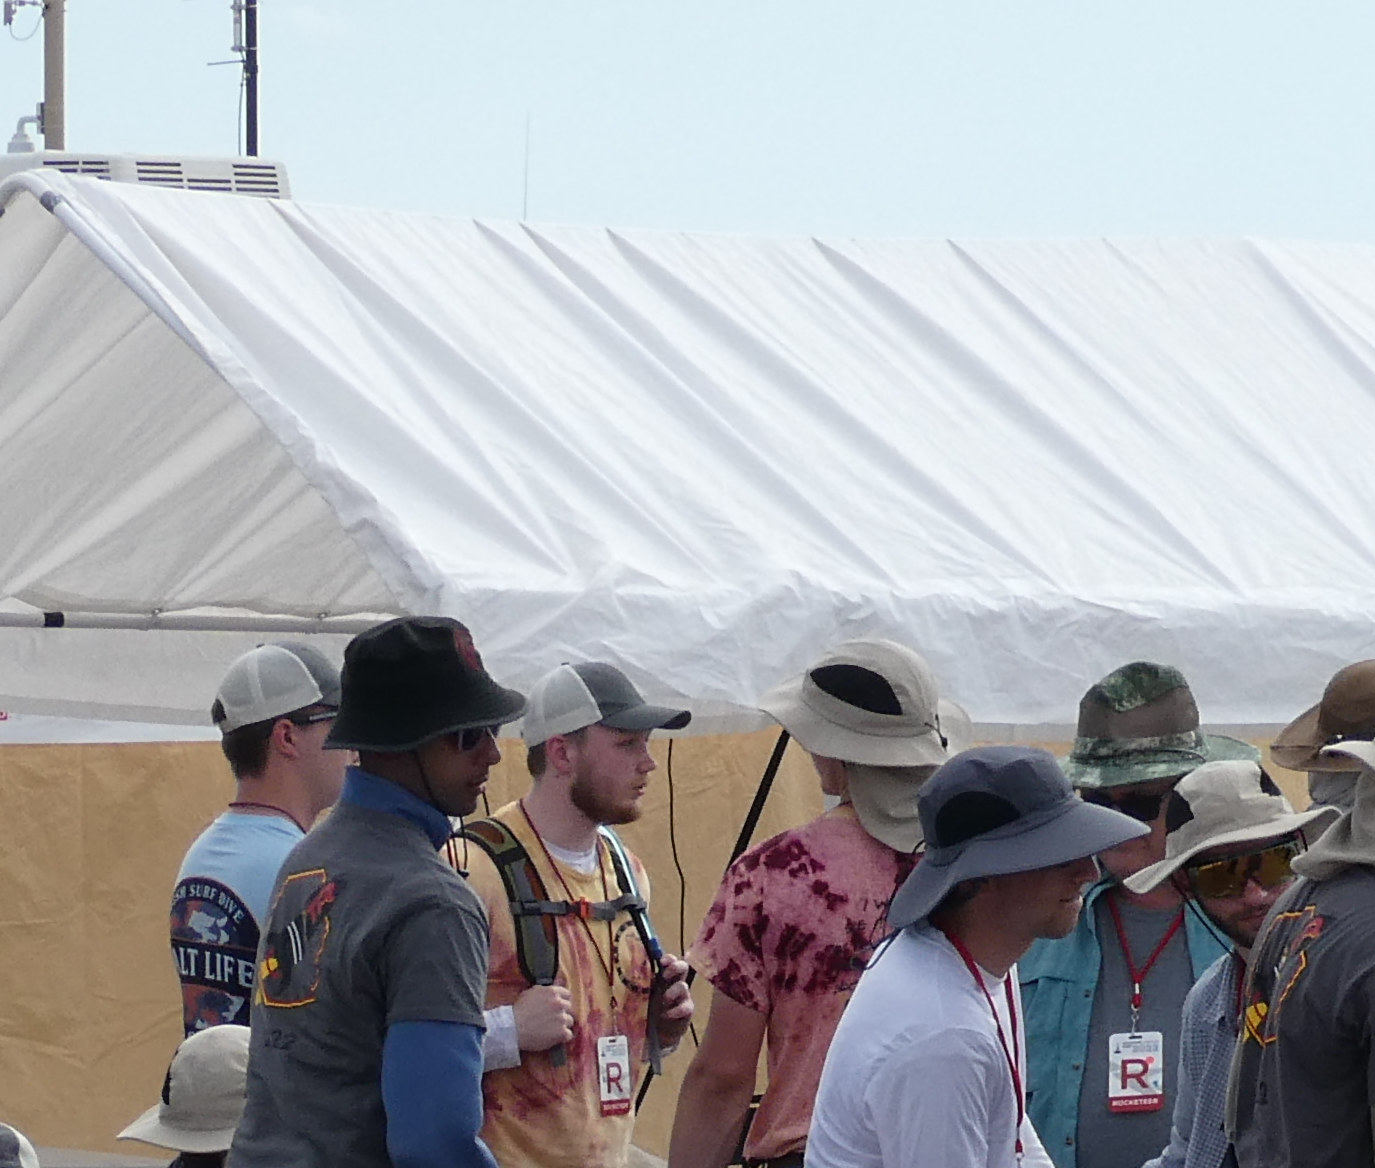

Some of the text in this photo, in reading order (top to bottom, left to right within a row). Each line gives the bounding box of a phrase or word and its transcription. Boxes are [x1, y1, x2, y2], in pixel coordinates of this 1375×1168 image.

[190, 884, 217, 901] SURF
[218, 892, 244, 924] DIVE
[174, 947, 255, 988] LT LIFE
[606, 1062, 623, 1094] R
[1121, 1058, 1149, 1090] R
